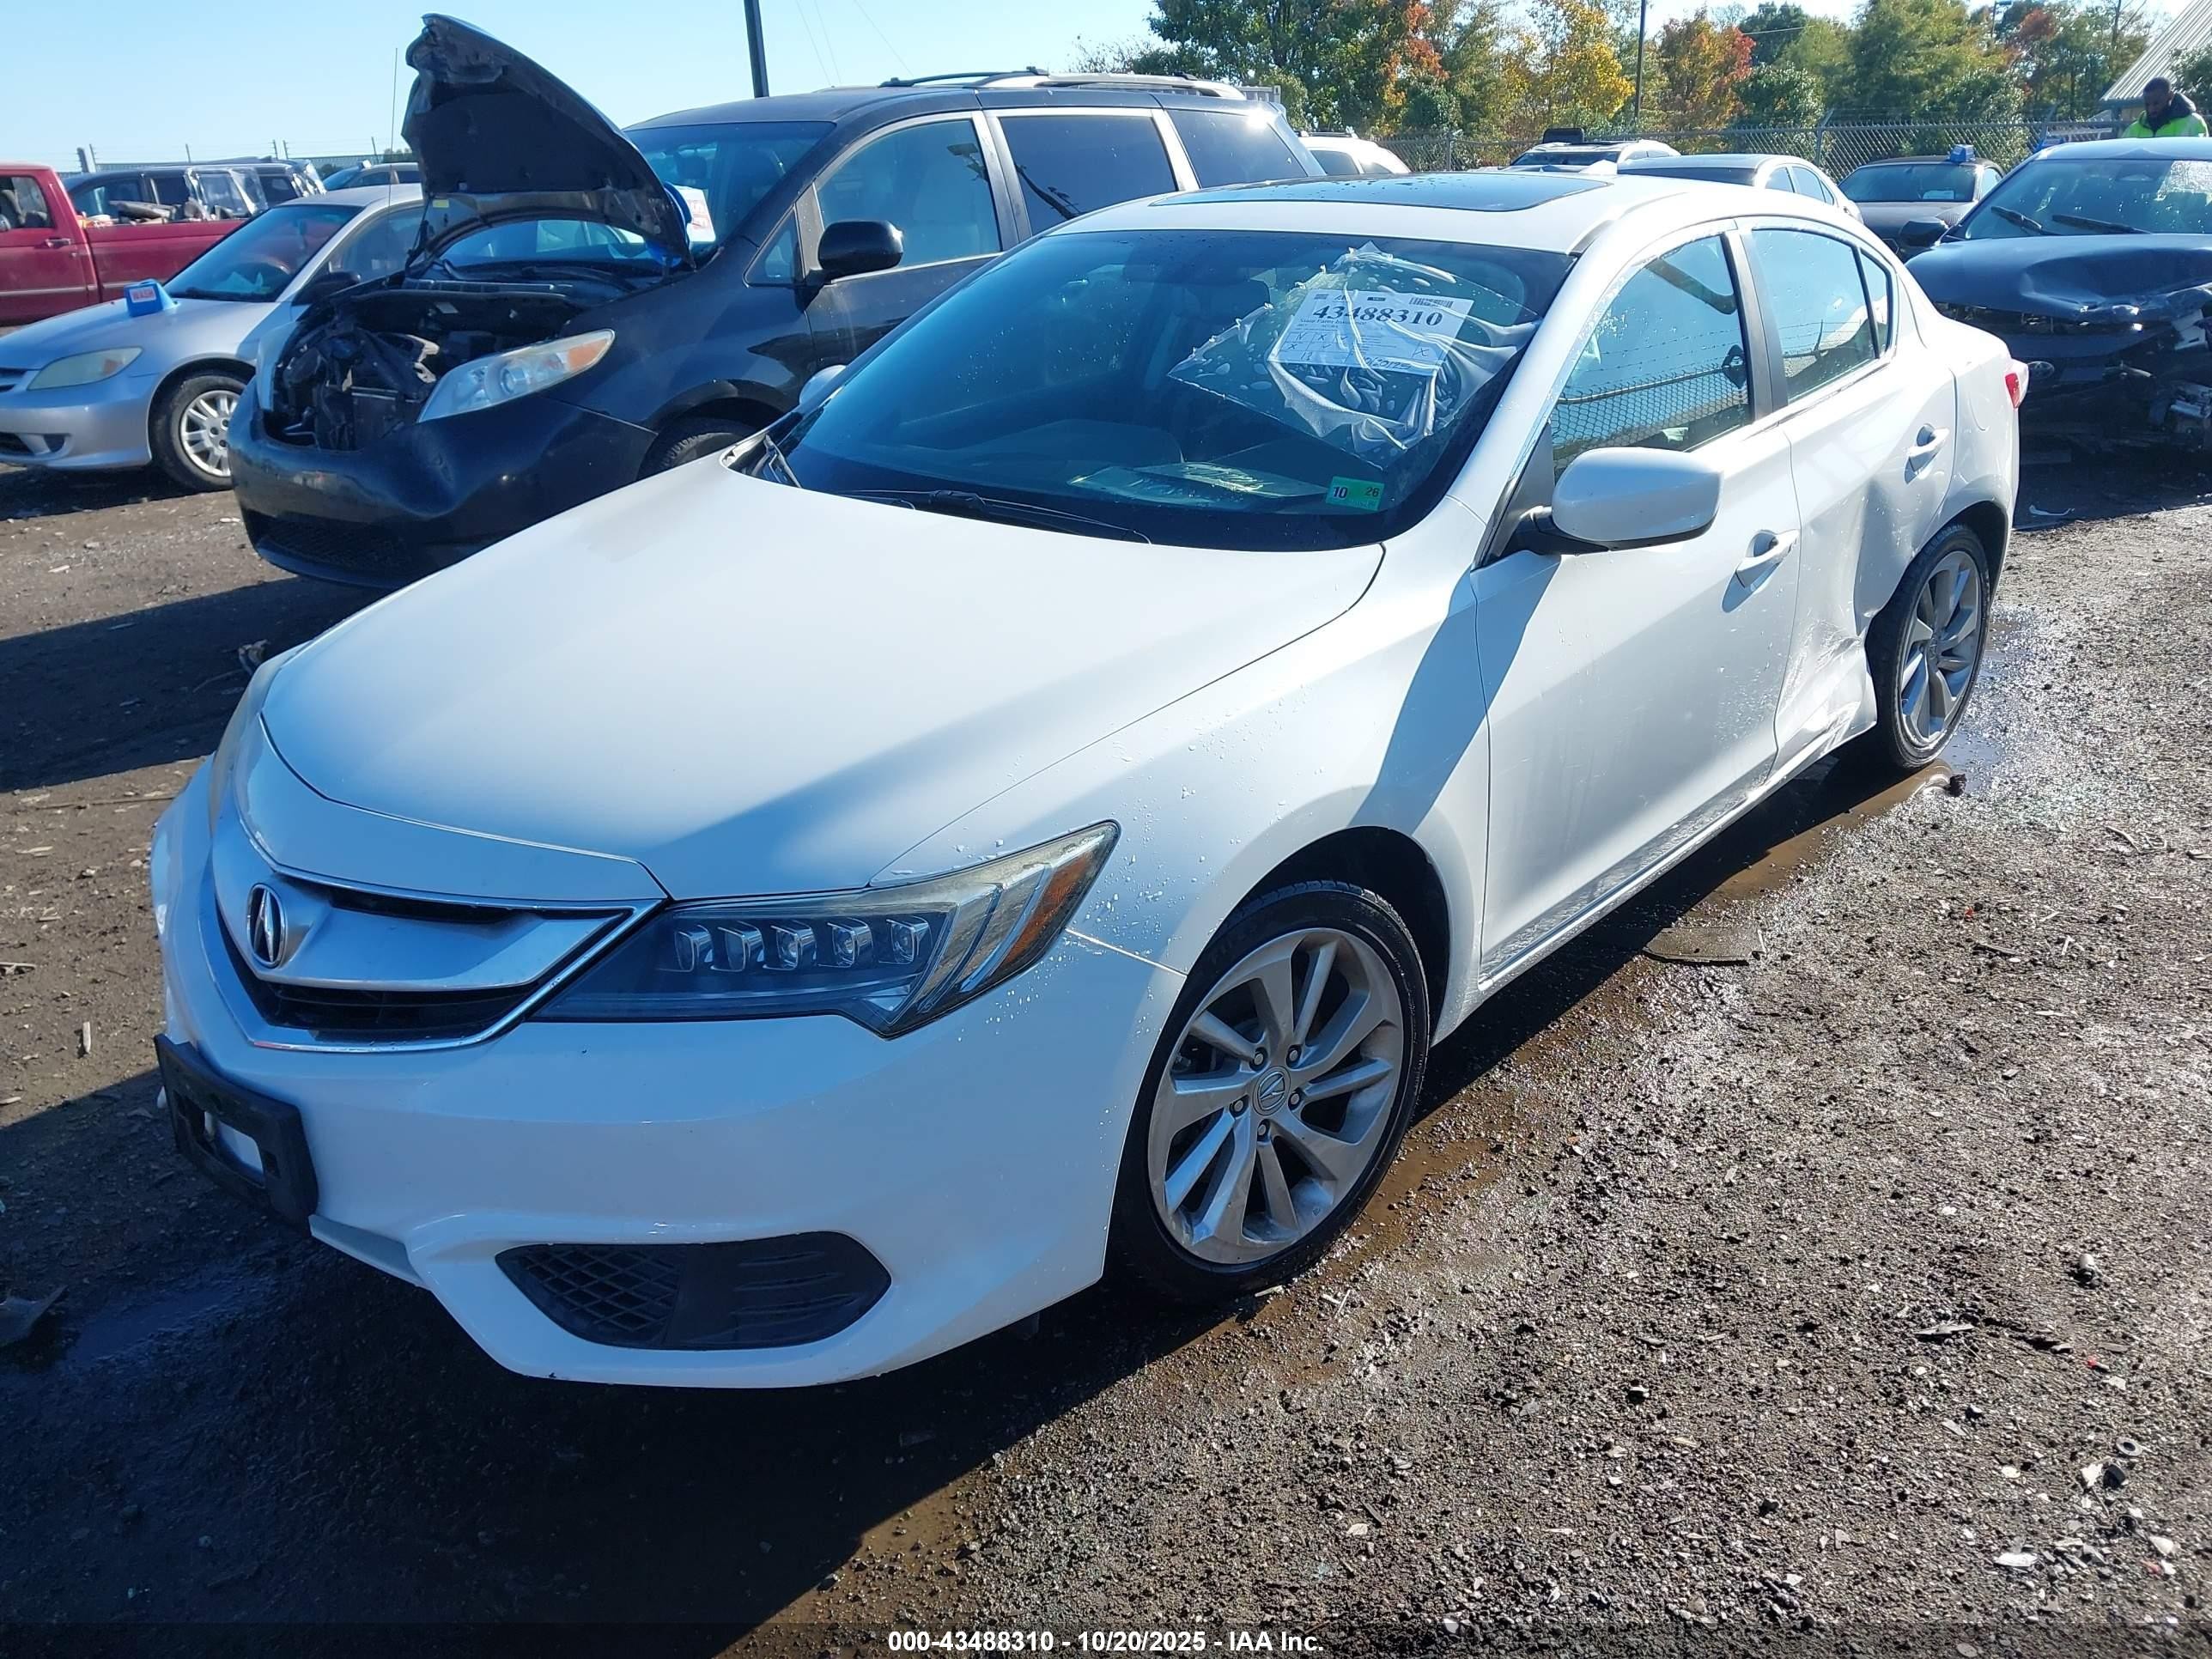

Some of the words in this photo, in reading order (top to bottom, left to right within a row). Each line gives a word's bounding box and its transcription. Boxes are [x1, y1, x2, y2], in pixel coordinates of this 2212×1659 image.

[1312, 304, 1443, 326] 43488310
[1333, 486, 1348, 499] 10
[1365, 486, 1380, 498] 26
